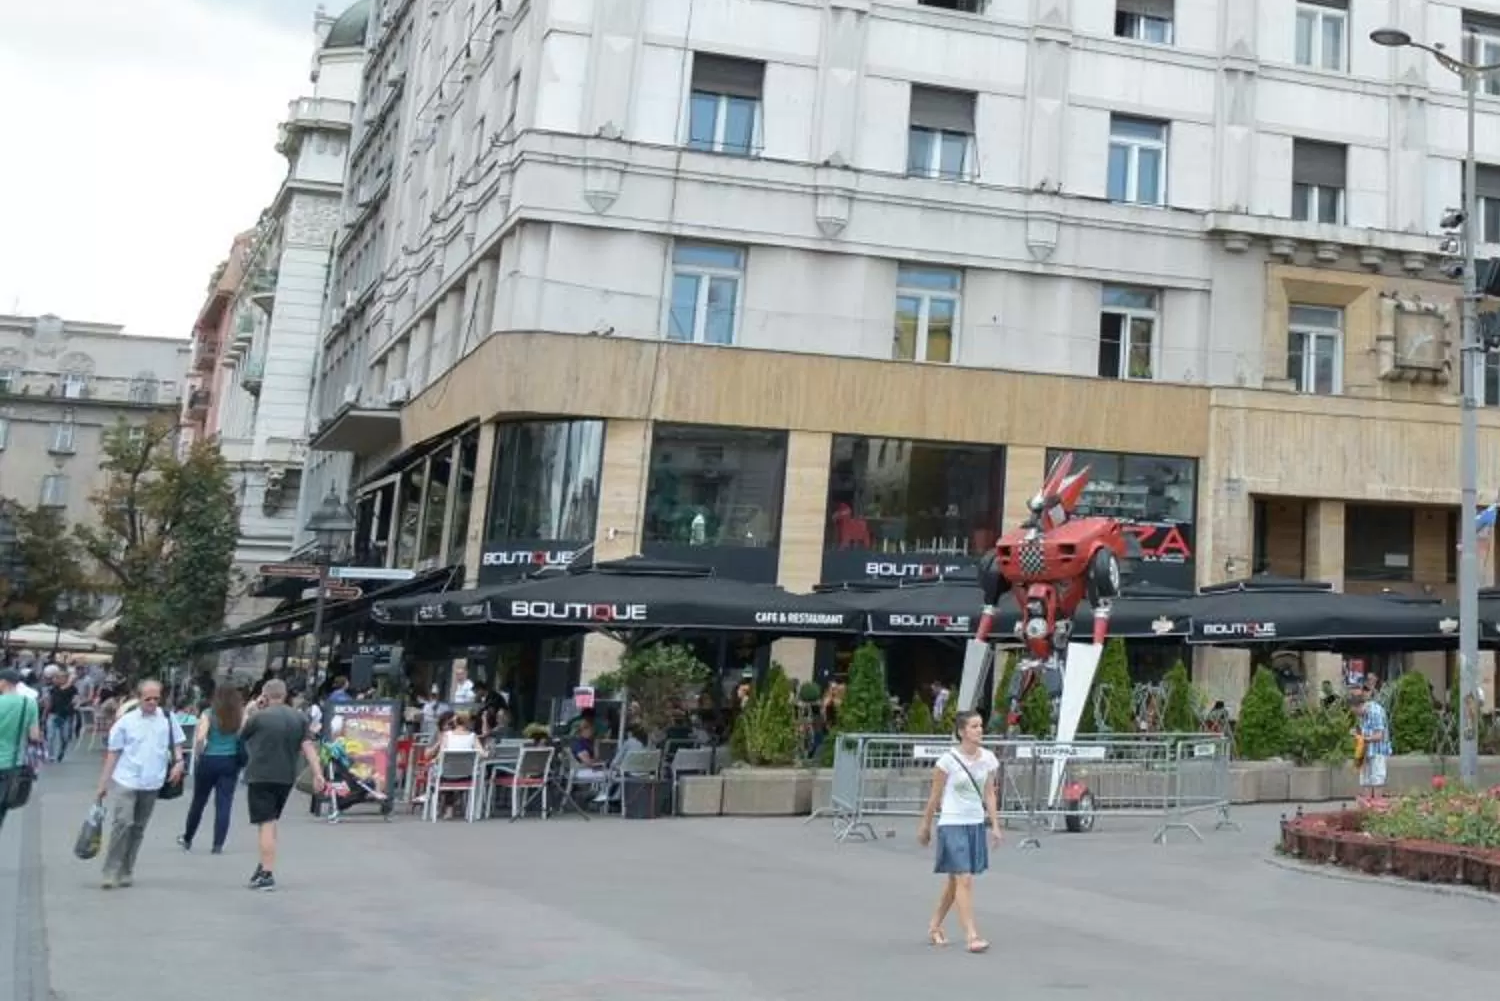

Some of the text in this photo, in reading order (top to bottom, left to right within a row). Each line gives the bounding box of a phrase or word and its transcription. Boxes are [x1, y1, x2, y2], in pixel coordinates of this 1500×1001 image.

[482, 551, 575, 566] BOUTIQUE
[512, 601, 648, 622] BOUTIQUE
[889, 614, 970, 628] BOUTIQUE
[1203, 622, 1276, 635] BOUTIQUE
